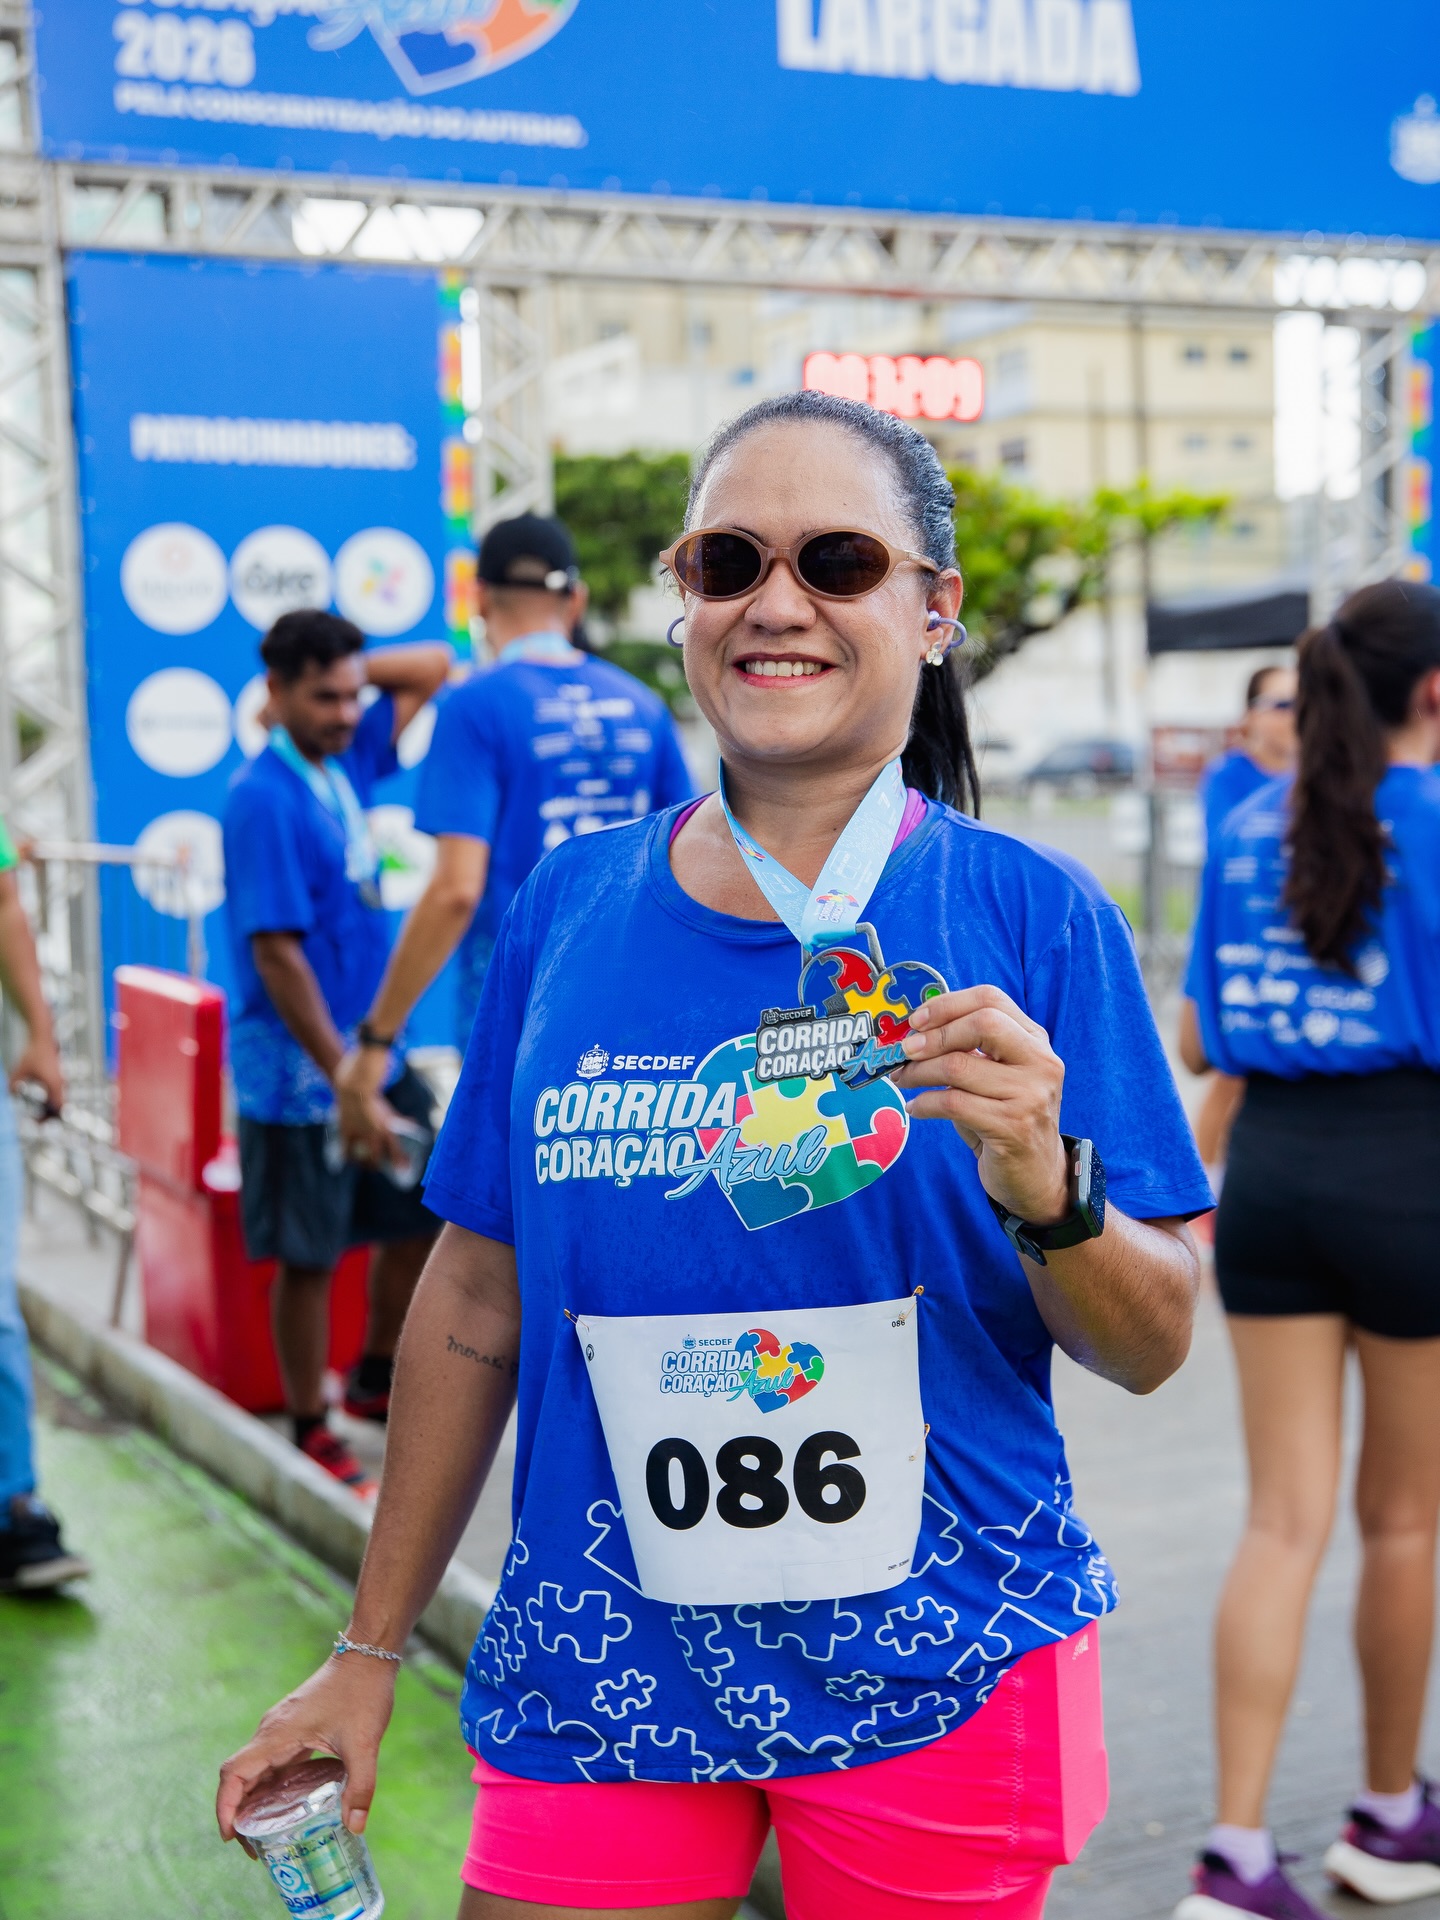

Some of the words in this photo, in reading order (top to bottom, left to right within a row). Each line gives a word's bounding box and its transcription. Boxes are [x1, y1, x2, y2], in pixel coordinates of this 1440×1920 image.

[112, 9, 256, 87] 2026
[776, 0, 1141, 97] LARGADA
[759, 1014, 871, 1056] CORRIDA
[778, 1008, 813, 1021] SECDEF
[612, 1055, 696, 1071] SECDEF
[757, 1045, 850, 1076] CORAÇÃO
[839, 1036, 908, 1081] Azu
[534, 1080, 738, 1138] CORRIDA
[535, 1127, 696, 1188] CORAÇÃO
[665, 1125, 828, 1200] Azul
[698, 1338, 733, 1347] SECDEF
[891, 1320, 906, 1328] 086
[661, 1349, 755, 1373] CORRIDA
[660, 1371, 739, 1397] CORAÇÃO
[726, 1367, 795, 1402] Azul
[645, 1430, 867, 1531] 086
